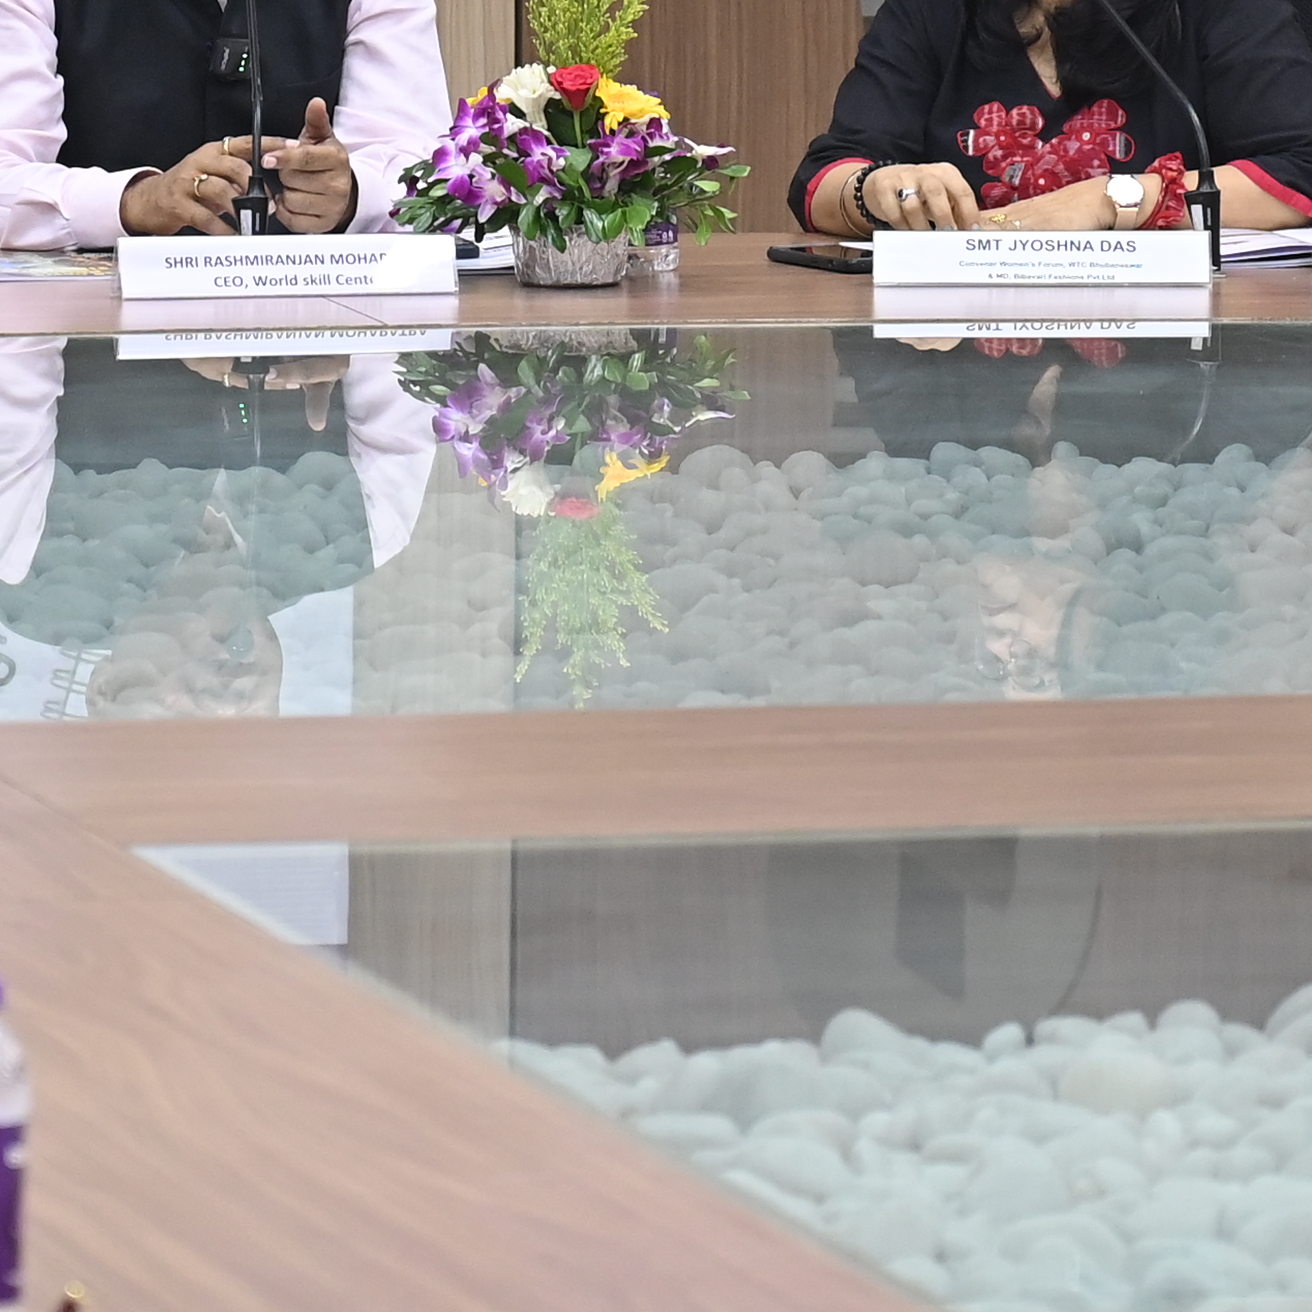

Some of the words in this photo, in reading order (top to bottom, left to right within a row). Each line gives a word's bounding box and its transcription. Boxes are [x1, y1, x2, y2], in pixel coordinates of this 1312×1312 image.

[965, 238, 1003, 251] SMT
[1008, 239, 1095, 252] JYOSHNA
[1100, 240, 1137, 253] DAS
[165, 256, 199, 268] SHRI
[204, 254, 325, 268] RASHMIRANJAN
[214, 275, 249, 289] CEO,
[253, 274, 298, 287] World
[303, 274, 331, 286] skill
